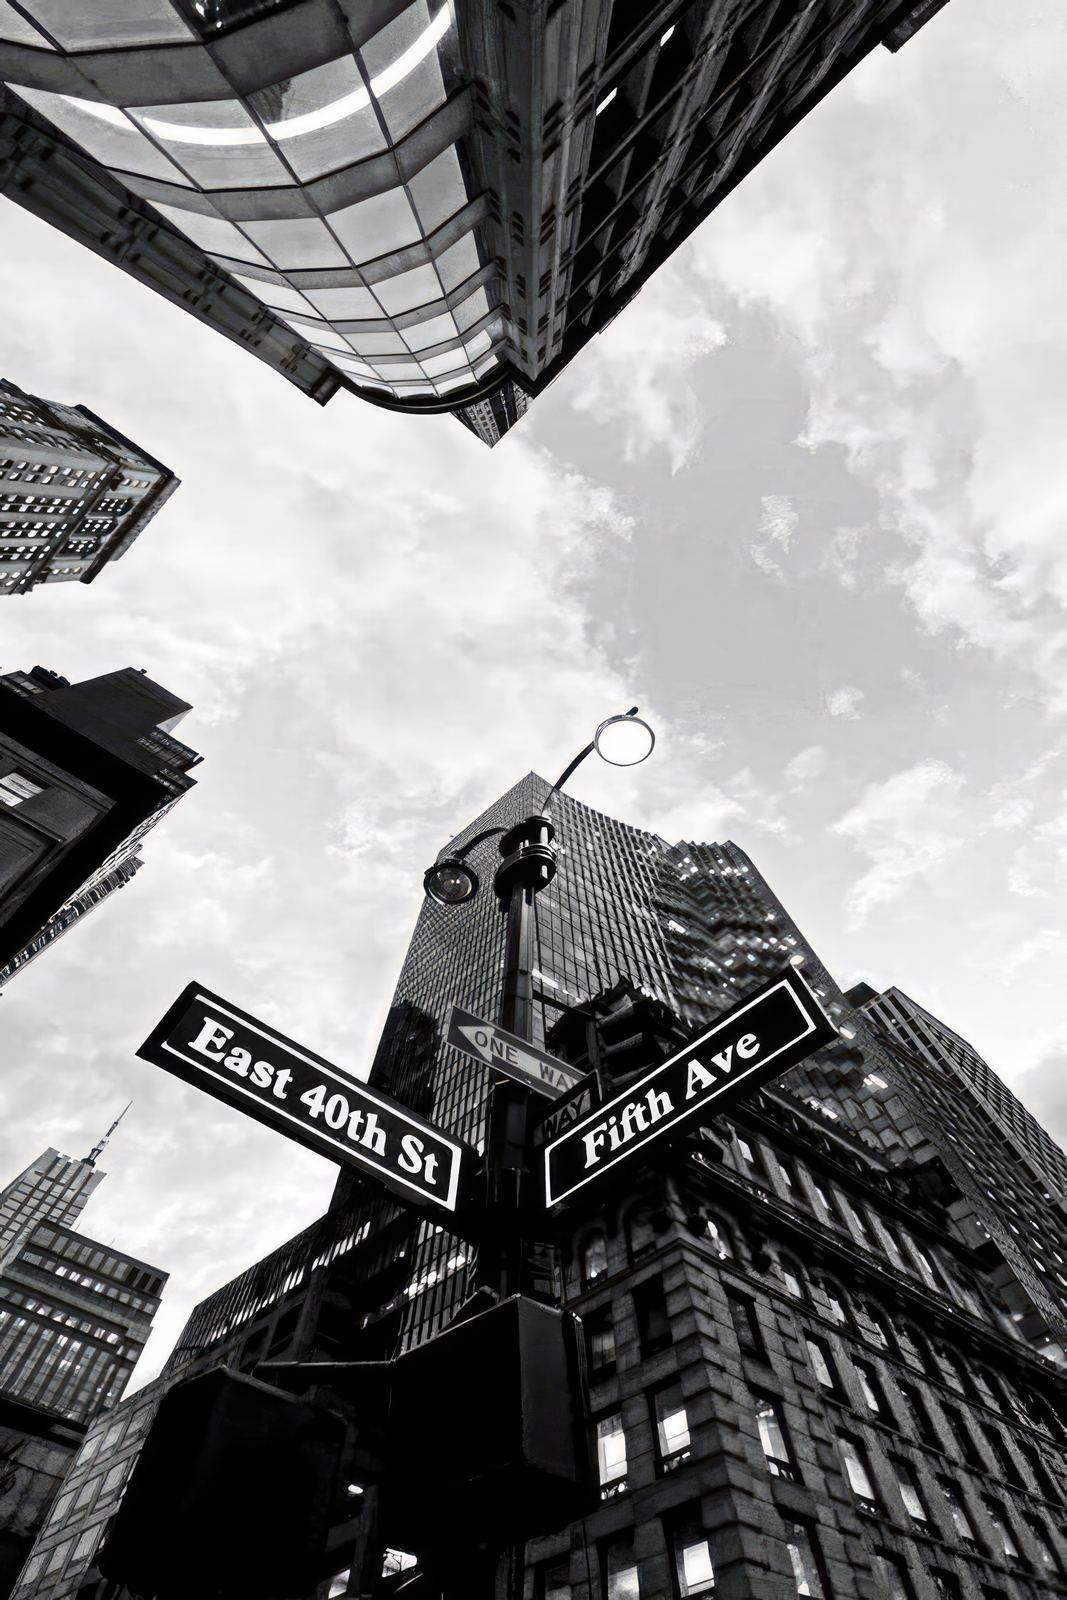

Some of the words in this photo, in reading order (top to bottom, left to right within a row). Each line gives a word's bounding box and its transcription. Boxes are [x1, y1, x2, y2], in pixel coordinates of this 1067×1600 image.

[474, 1030, 519, 1065] ONE
[188, 1017, 293, 1099] East
[300, 1085, 386, 1156] 40th
[398, 1135, 438, 1184] St
[543, 1091, 587, 1142] WAY
[582, 1087, 675, 1168] Fifth
[686, 1033, 760, 1099] Ave
